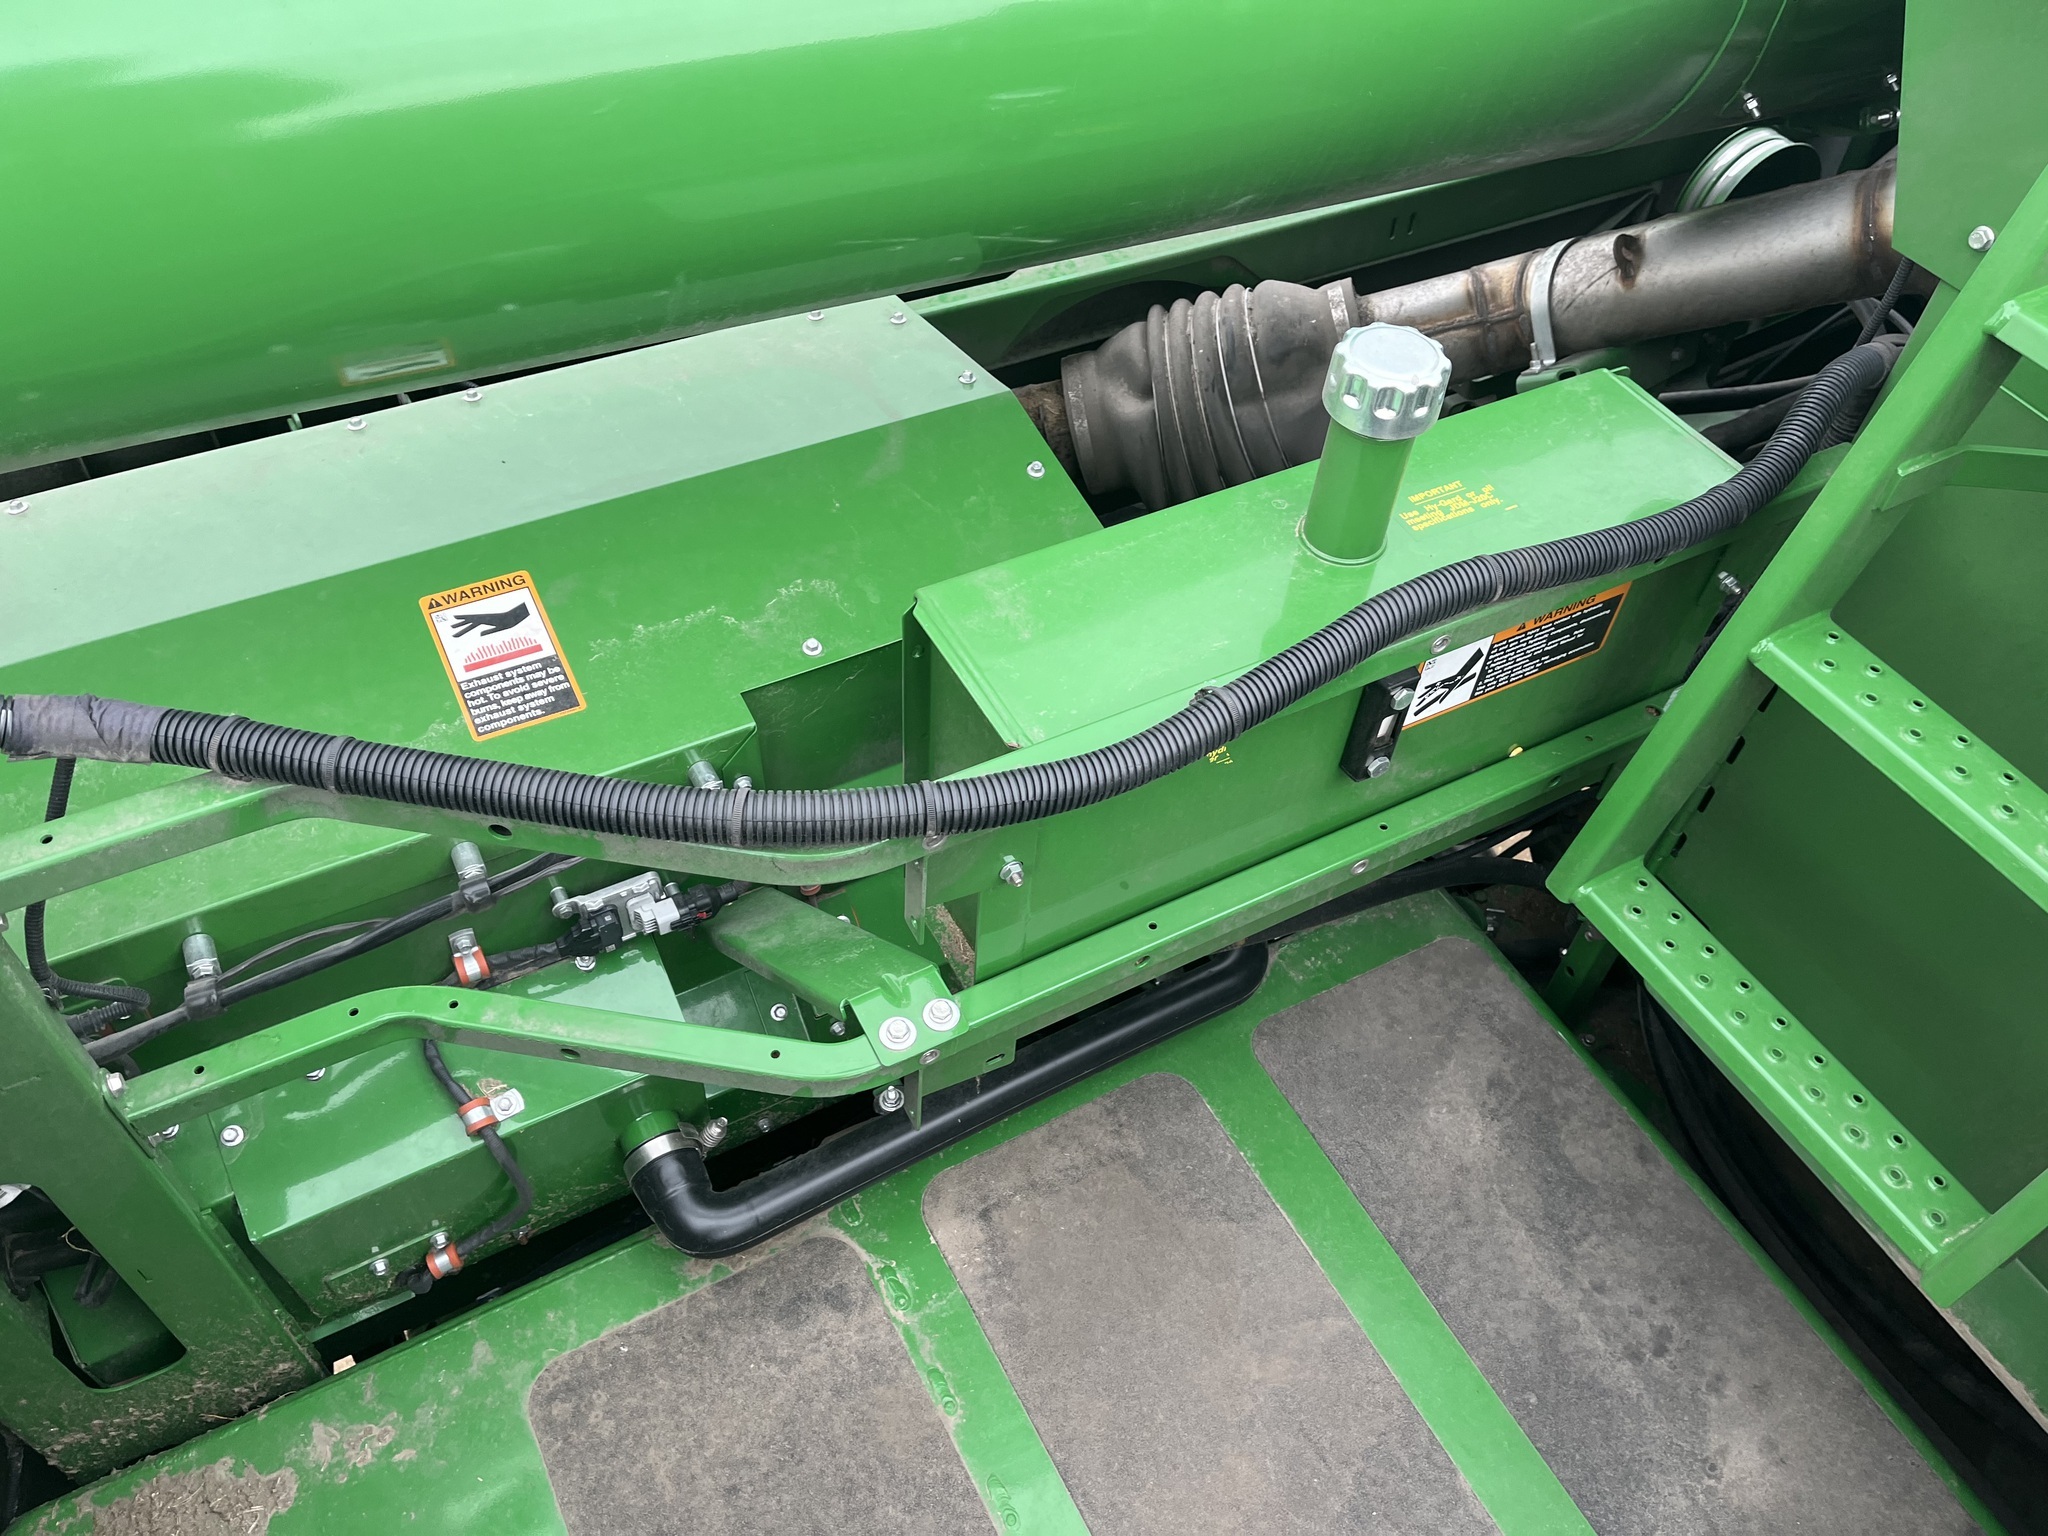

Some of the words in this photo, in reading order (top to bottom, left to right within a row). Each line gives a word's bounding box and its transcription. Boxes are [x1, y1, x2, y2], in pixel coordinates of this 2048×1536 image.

[1408, 480, 1463, 503] IMPORTANT
[1399, 510, 1420, 520] Use
[1406, 509, 1446, 526] meeting
[1411, 506, 1475, 531] specifications
[441, 575, 527, 605] WARNING
[1533, 595, 1597, 625] WARNING
[460, 672, 504, 690] Exhaust
[504, 662, 542, 678] system
[464, 676, 525, 699] components
[525, 669, 547, 682] may
[547, 665, 561, 675] be
[466, 697, 488, 707] hot.
[486, 693, 501, 701] To
[502, 685, 530, 698] avoid
[531, 674, 565, 689] severe
[470, 702, 501, 716] burns,
[500, 695, 524, 707] keep
[524, 688, 548, 701] away
[548, 681, 570, 693] from
[473, 706, 516, 725] exhaust
[517, 695, 555, 711] system
[477, 708, 545, 733] components.
